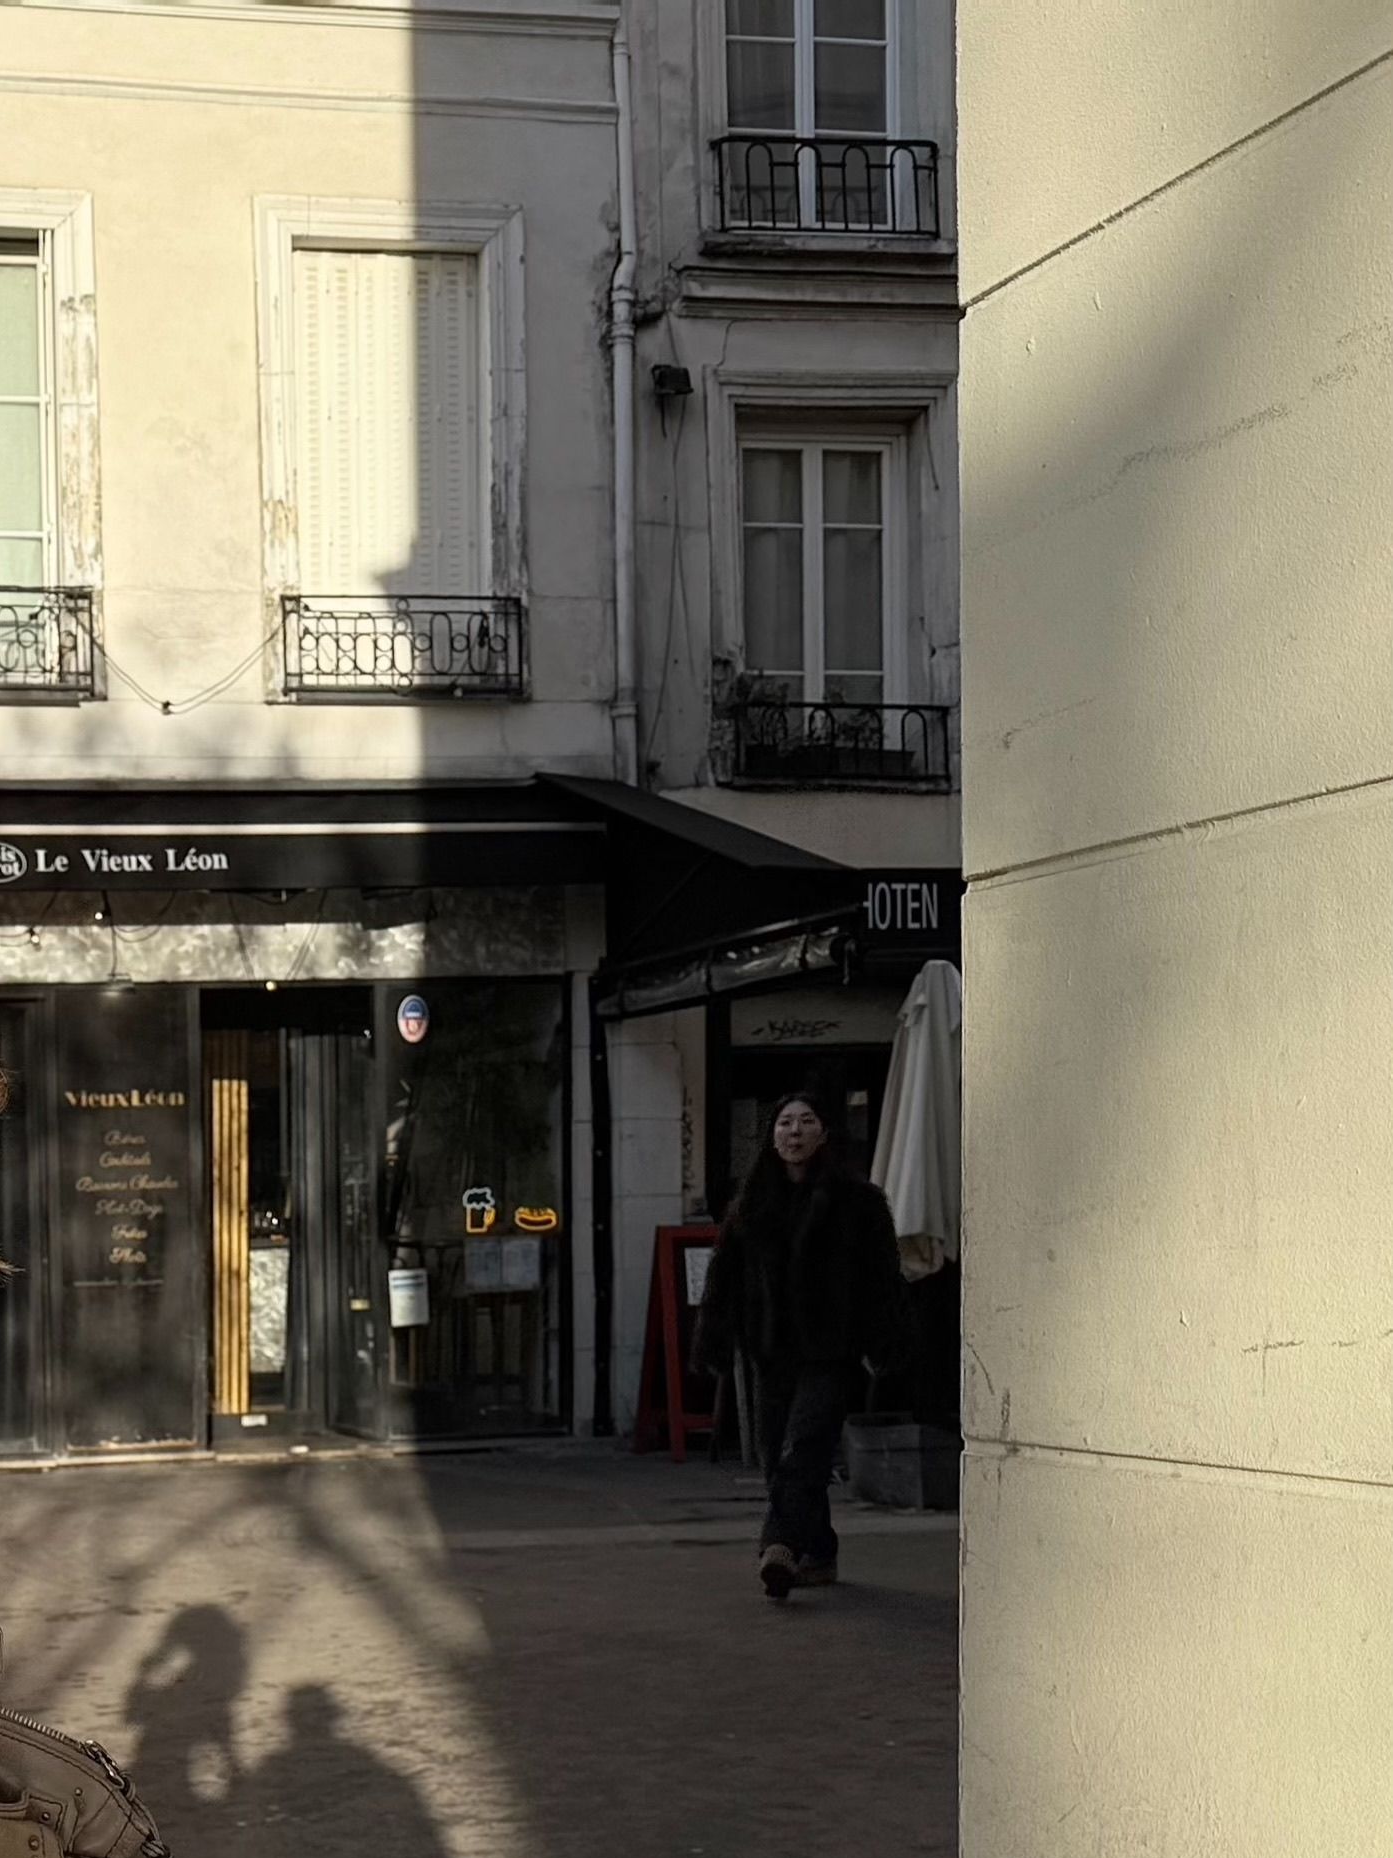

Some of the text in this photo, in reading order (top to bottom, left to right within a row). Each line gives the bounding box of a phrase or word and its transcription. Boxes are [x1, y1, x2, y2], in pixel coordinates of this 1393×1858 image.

[35, 847, 229, 872] Le Vieux Léon
